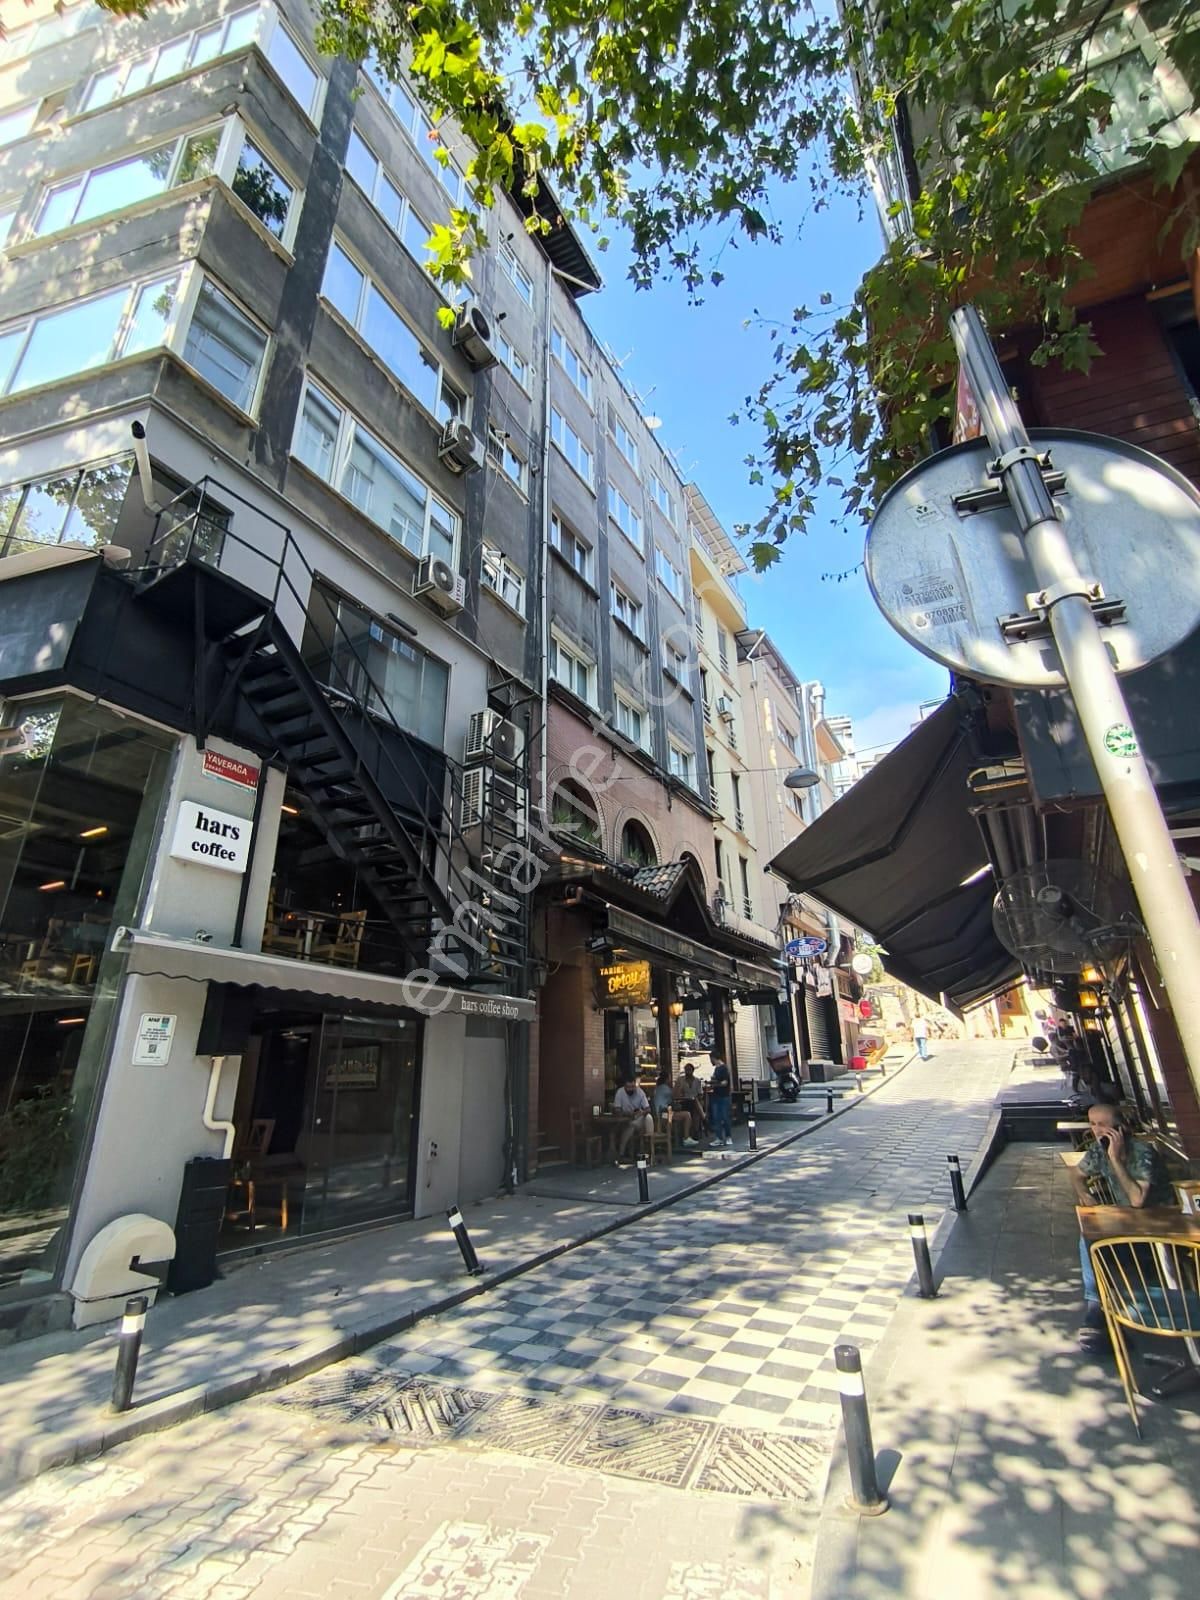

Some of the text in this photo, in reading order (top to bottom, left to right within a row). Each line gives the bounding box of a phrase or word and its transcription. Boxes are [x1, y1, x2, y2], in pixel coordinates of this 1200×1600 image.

[195, 811, 240, 841] hars
[191, 839, 237, 862] coffee
[461, 996, 519, 1019] hars coffee shop
